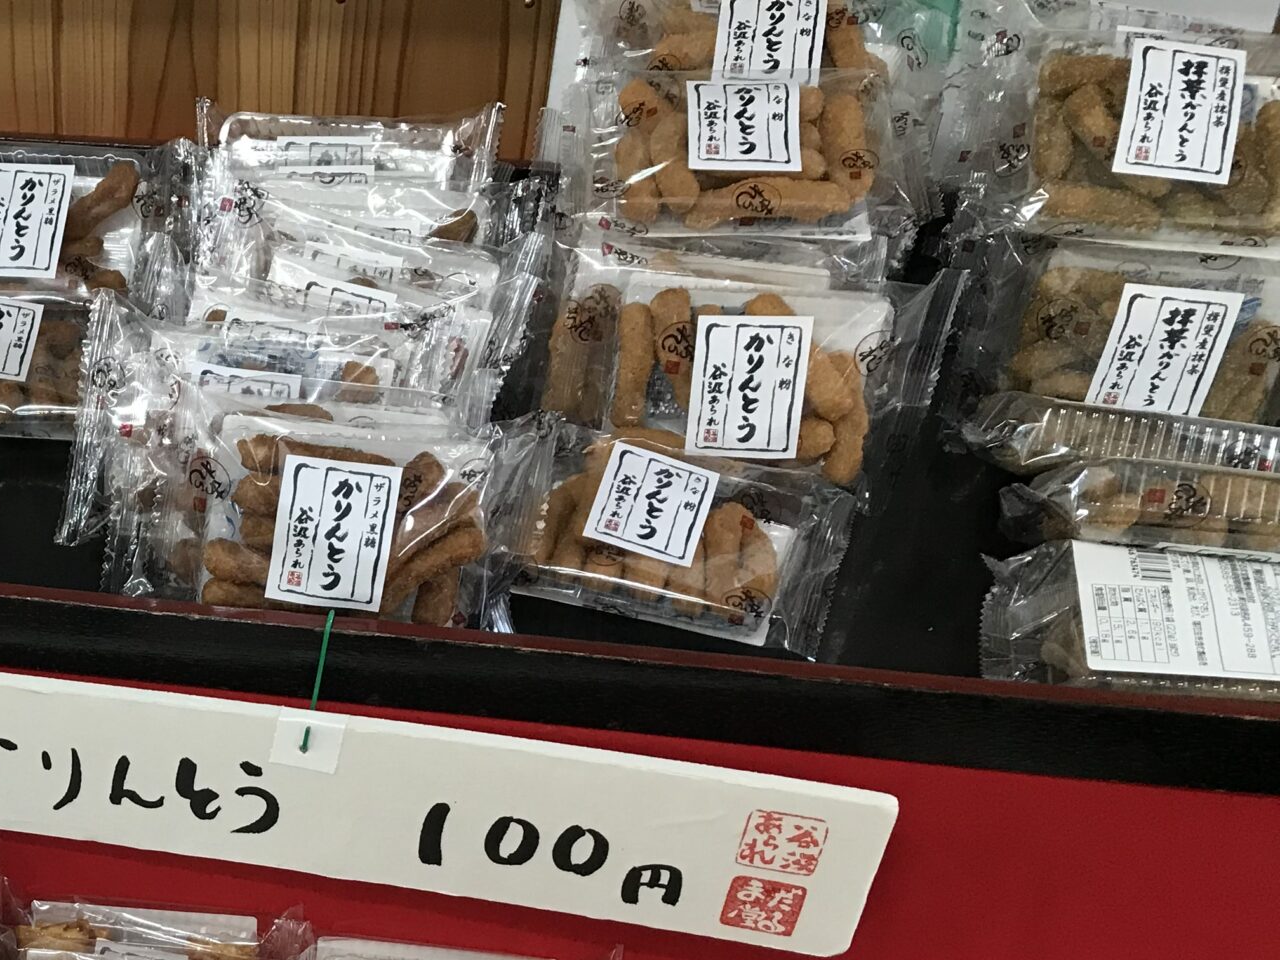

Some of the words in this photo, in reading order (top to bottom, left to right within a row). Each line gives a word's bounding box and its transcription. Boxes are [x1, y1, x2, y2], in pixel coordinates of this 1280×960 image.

[762, 0, 793, 74] かりんとう
[734, 87, 761, 154] かりんとう
[1175, 59, 1209, 162] 抹茶かりんとう
[9, 177, 44, 261] かりんとう
[736, 332, 773, 443] かりんとう
[778, 332, 795, 391] きな粉
[1142, 307, 1198, 407] 抹茶かりんとう
[320, 478, 363, 591] かりんとう
[364, 482, 385, 549] ザラメ黒糖
[636, 468, 682, 540] かりんとう
[419, 802, 683, 906] 100円
